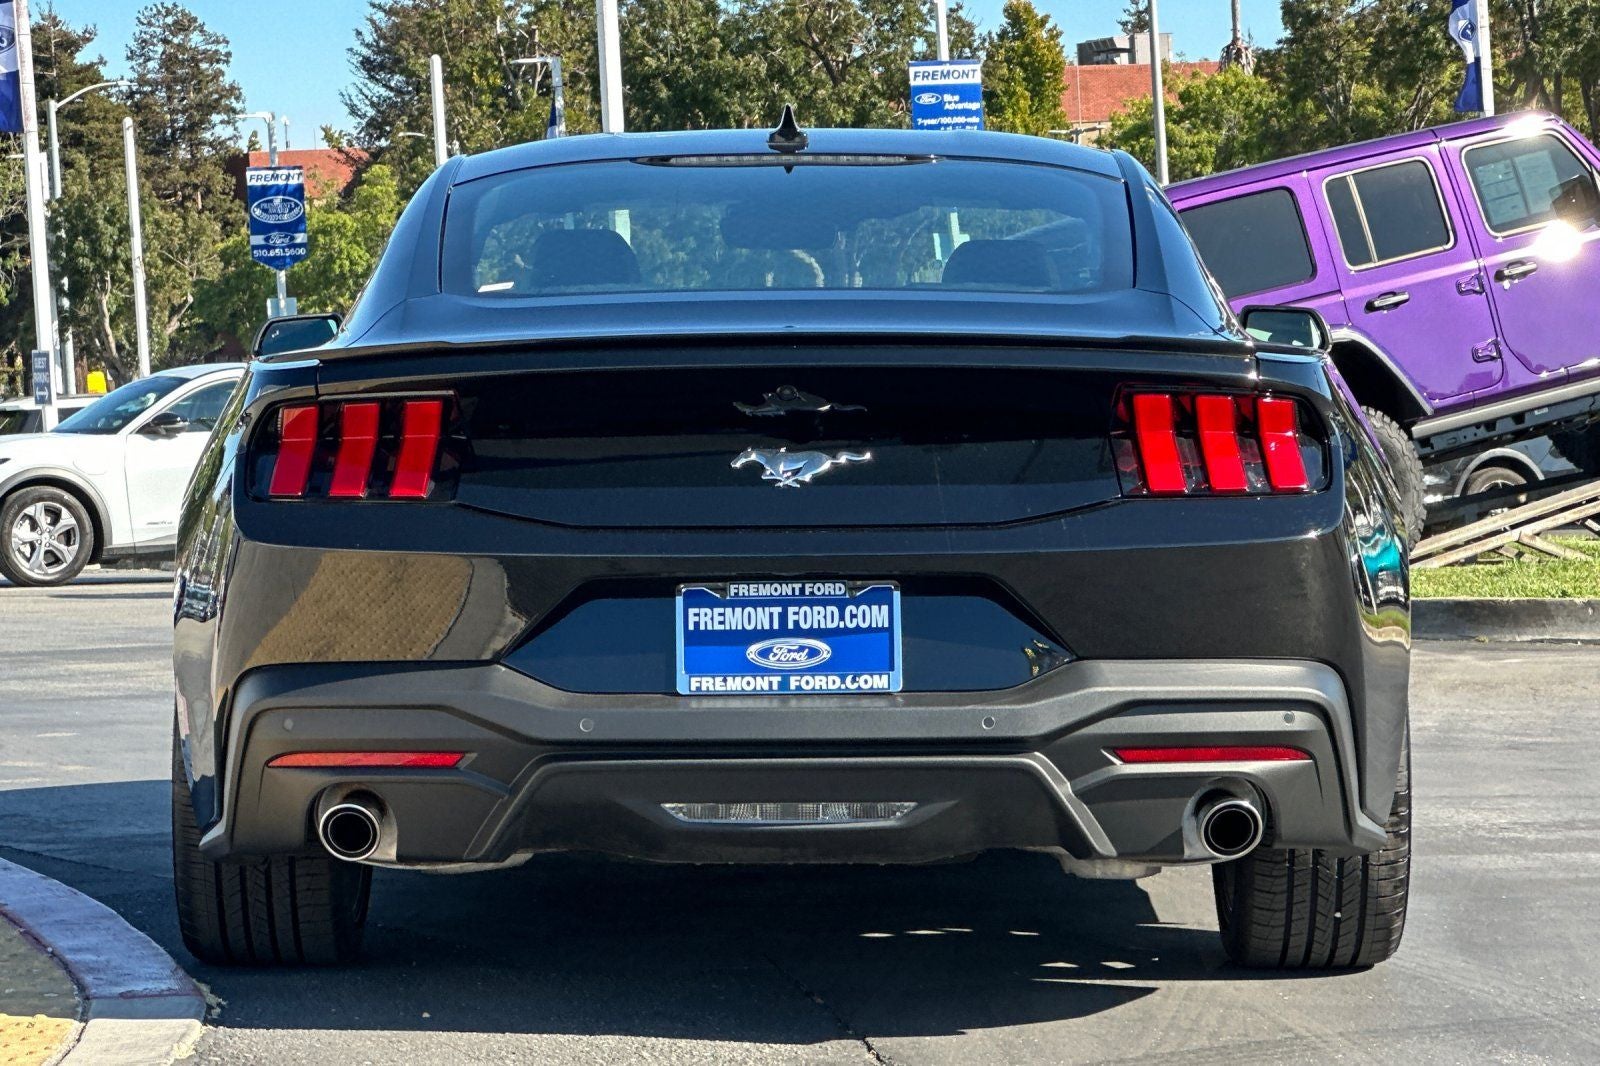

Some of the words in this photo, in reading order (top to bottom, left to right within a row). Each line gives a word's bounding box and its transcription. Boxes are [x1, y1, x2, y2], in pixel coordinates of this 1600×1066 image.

[913, 69, 978, 81] FREMONT
[943, 94, 960, 102] Blue
[944, 101, 981, 111] Advantage
[249, 171, 303, 183] FREMONT
[269, 233, 291, 244] Ford
[729, 583, 802, 597] FREMONT
[804, 582, 846, 596] FORD
[688, 606, 782, 631] FREMONT
[787, 604, 889, 630] FORD.COM
[768, 645, 808, 662] Ford
[690, 675, 782, 691] FREMONT
[789, 674, 889, 690] FORD.COM
